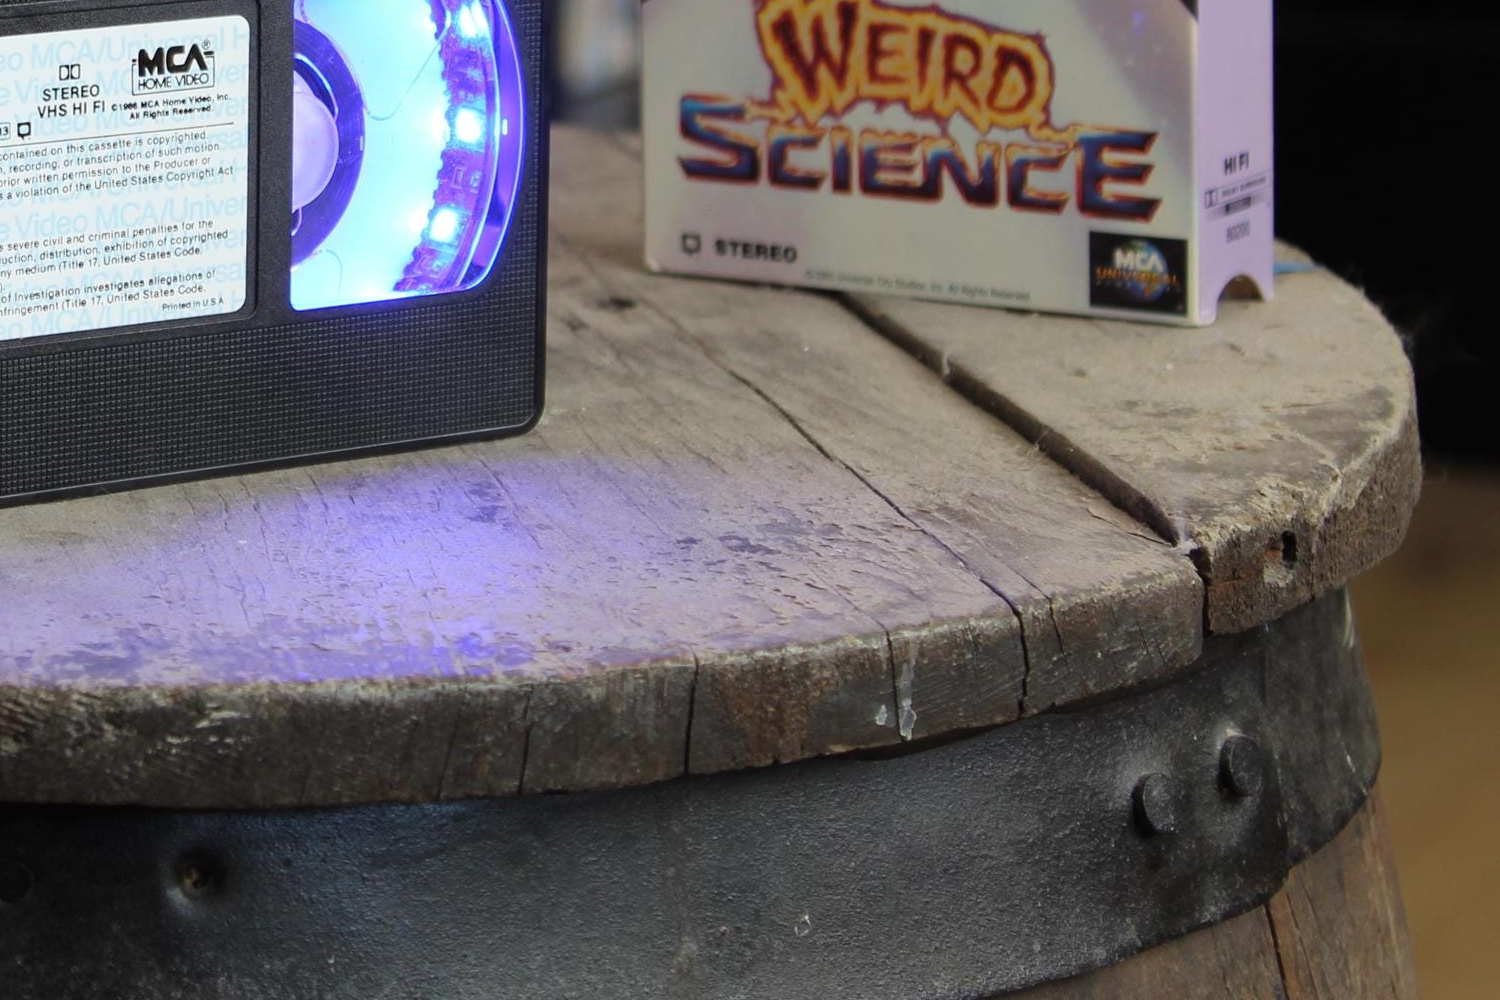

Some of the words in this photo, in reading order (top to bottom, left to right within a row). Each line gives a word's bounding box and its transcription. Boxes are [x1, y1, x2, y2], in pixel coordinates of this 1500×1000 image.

[42, 84, 100, 102] STEREO
[138, 75, 172, 91] HOME
[175, 72, 209, 86] VIDEO
[37, 103, 67, 118] VHS
[73, 101, 87, 115] HI
[93, 100, 105, 113] FI
[9, 160, 60, 174] recording,
[63, 159, 73, 168] or
[76, 151, 142, 166] transcription
[145, 148, 155, 159] of
[158, 146, 182, 158] such
[185, 143, 220, 154] motion
[50, 147, 63, 156] on
[66, 144, 85, 155] this
[88, 139, 132, 152] cassette
[135, 138, 143, 147] is
[678, 94, 1162, 223] SCIENCE
[23, 173, 59, 185] written
[62, 167, 118, 182] permission
[122, 165, 132, 174] to
[135, 163, 150, 173] the
[153, 158, 198, 170] Producer
[201, 157, 211, 166] or
[1223, 156, 1236, 176] HI
[1238, 151, 1249, 171] FI
[6, 191, 13, 201] a
[15, 186, 59, 198] violation
[62, 183, 73, 194] of
[75, 182, 92, 192] the
[94, 177, 128, 190] United
[130, 174, 163, 186] States
[166, 167, 214, 182] Copyright
[218, 165, 234, 176] Act
[7, 240, 40, 252] severe
[42, 236, 63, 247] civil
[66, 233, 85, 245] and
[88, 228, 129, 242] criminal
[132, 224, 179, 239] penalties
[181, 221, 195, 231] for
[198, 220, 214, 229] the
[39, 247, 101, 261] distribution,
[104, 240, 154, 254] exhibition
[157, 236, 167, 247] of
[170, 229, 229, 246] copyrighted
[15, 264, 56, 275] medium
[58, 260, 85, 272] (Title
[103, 253, 137, 266] United
[139, 250, 171, 262] States
[715, 238, 798, 264] STEREO
[1114, 247, 1164, 273] MCA
[0, 293, 12, 304] of
[14, 287, 81, 302] Investigation
[84, 279, 145, 294] investigates
[148, 272, 203, 287] allegations
[206, 269, 215, 280] of
[61, 298, 87, 310] (Title
[106, 291, 140, 305] United
[142, 288, 175, 300] States
[162, 301, 192, 311] Printed
